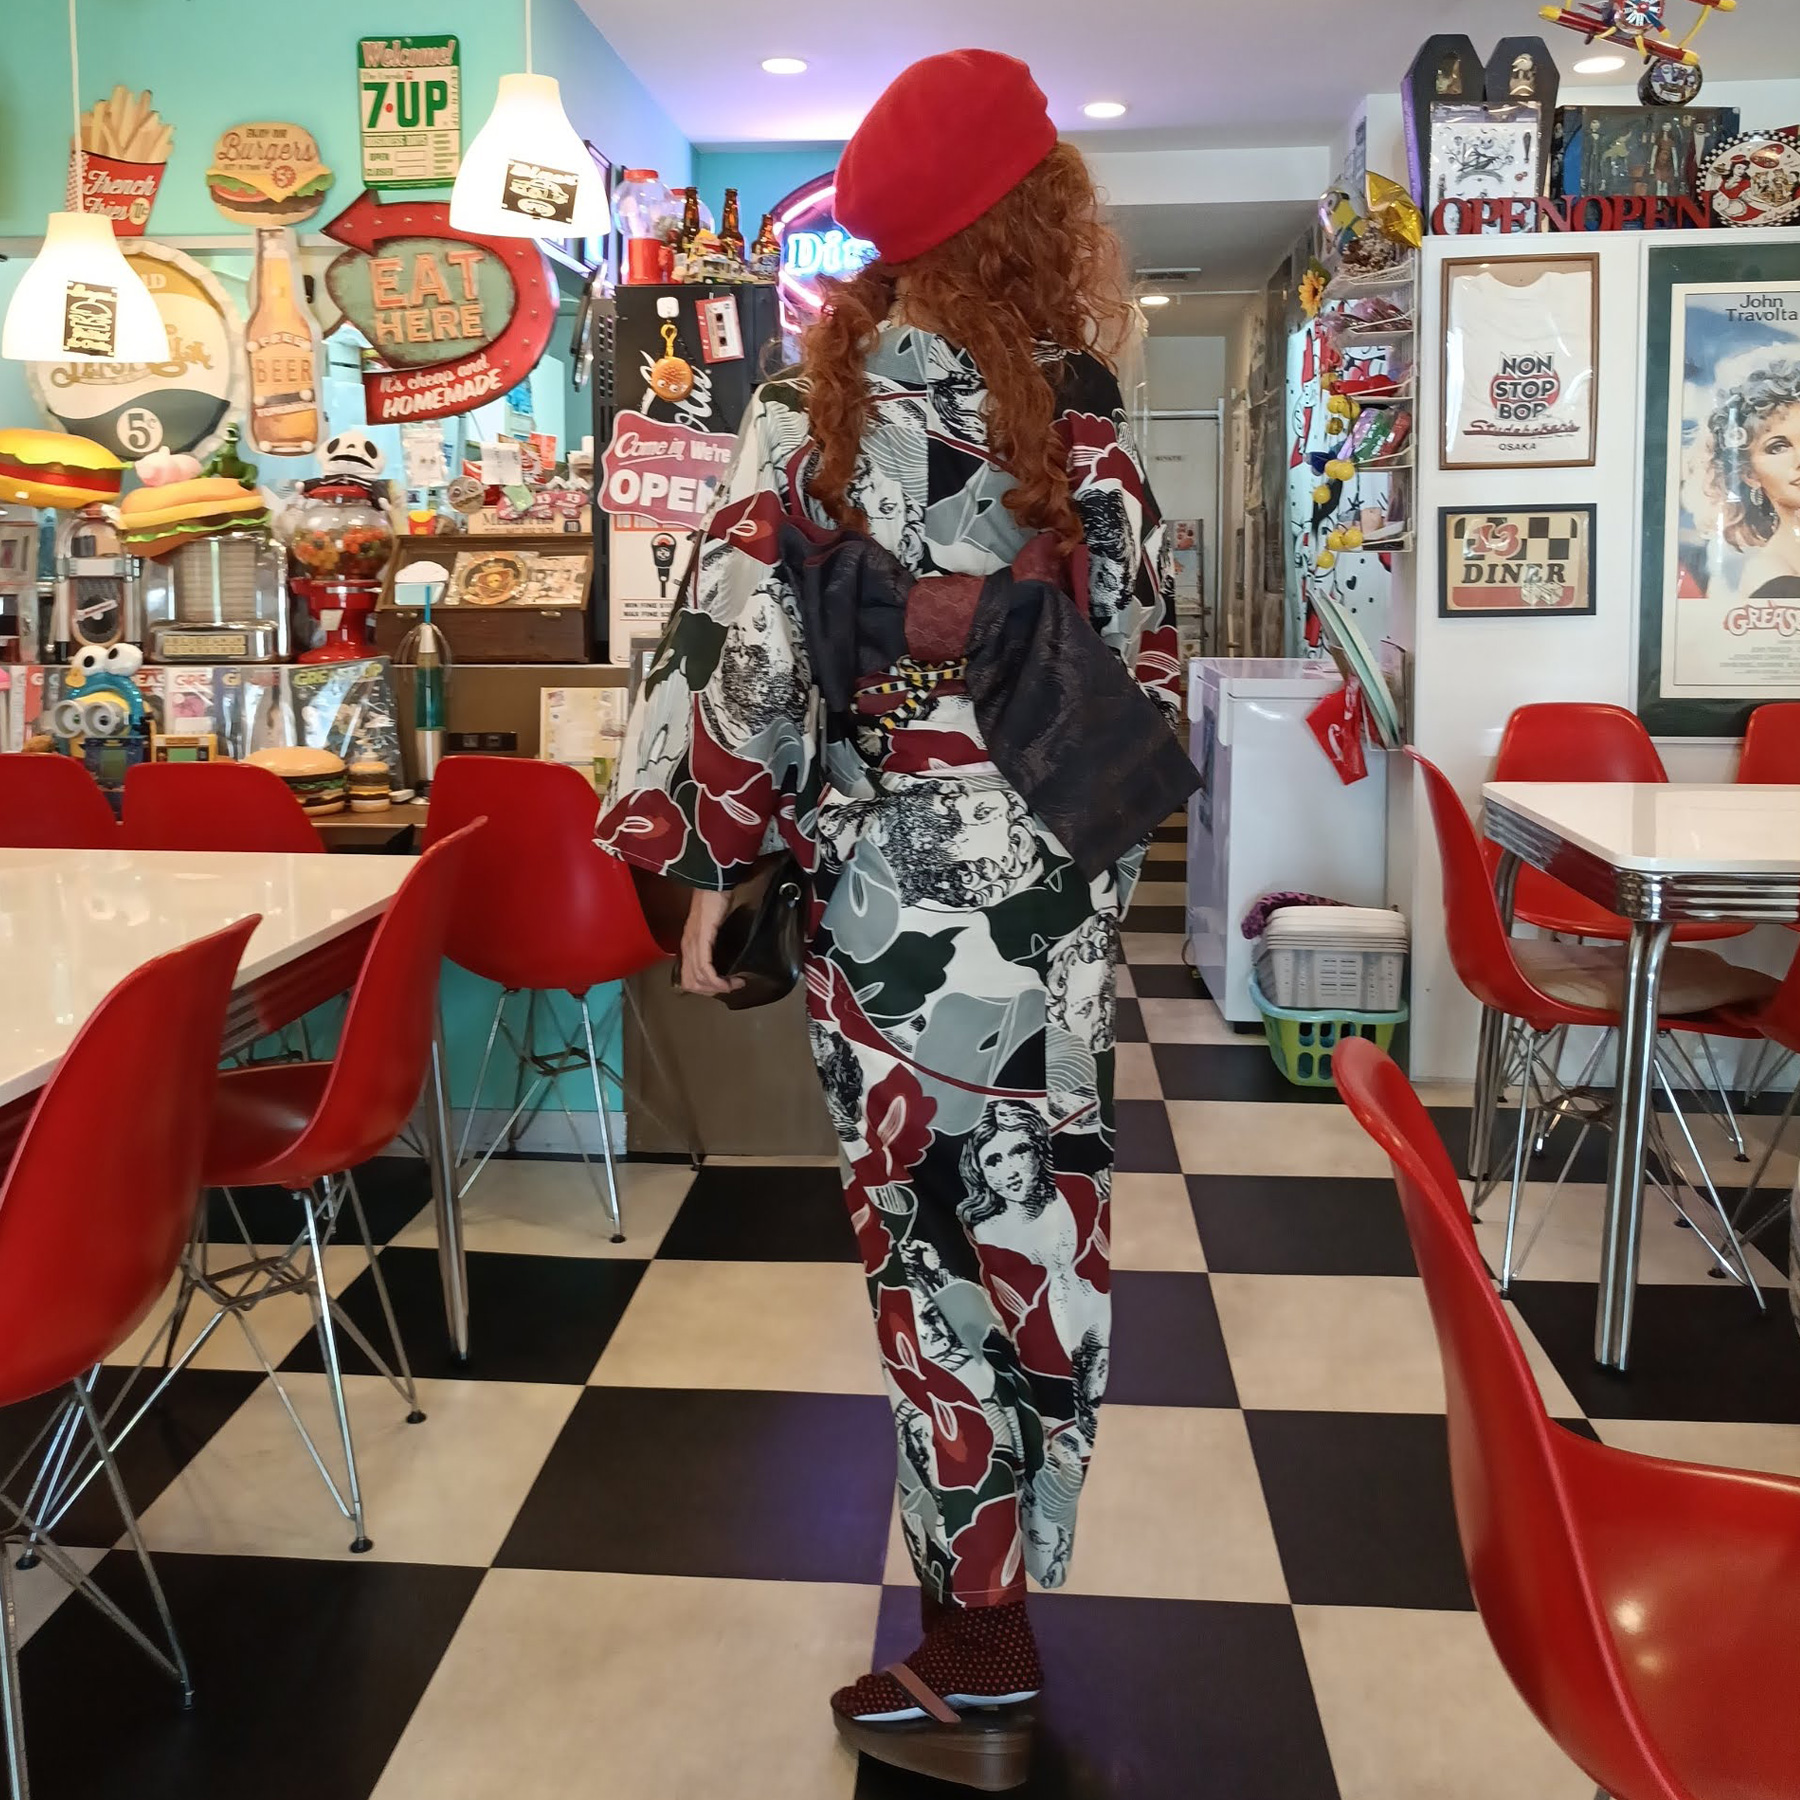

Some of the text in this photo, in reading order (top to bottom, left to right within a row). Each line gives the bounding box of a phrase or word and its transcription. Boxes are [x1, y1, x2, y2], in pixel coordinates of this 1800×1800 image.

[360, 39, 457, 67] Welcome!
[217, 132, 318, 170] Burgers
[83, 169, 157, 196] French
[368, 249, 485, 311] EAT
[1740, 293, 1783, 308] John
[374, 303, 485, 345] HERE
[1725, 307, 1798, 322] Travolta
[256, 358, 314, 383] BEER
[380, 353, 491, 393] It's cheap and
[1500, 352, 1554, 377] NON
[382, 368, 505, 419] HOMEMADE
[1494, 378, 1557, 400] STOP
[1498, 401, 1549, 421] BOP
[614, 431, 668, 459] Come
[1498, 442, 1537, 451] OSAKA
[1469, 521, 1521, 559] 13
[1461, 562, 1566, 584] DINER
[1723, 603, 1800, 637] GREAS
